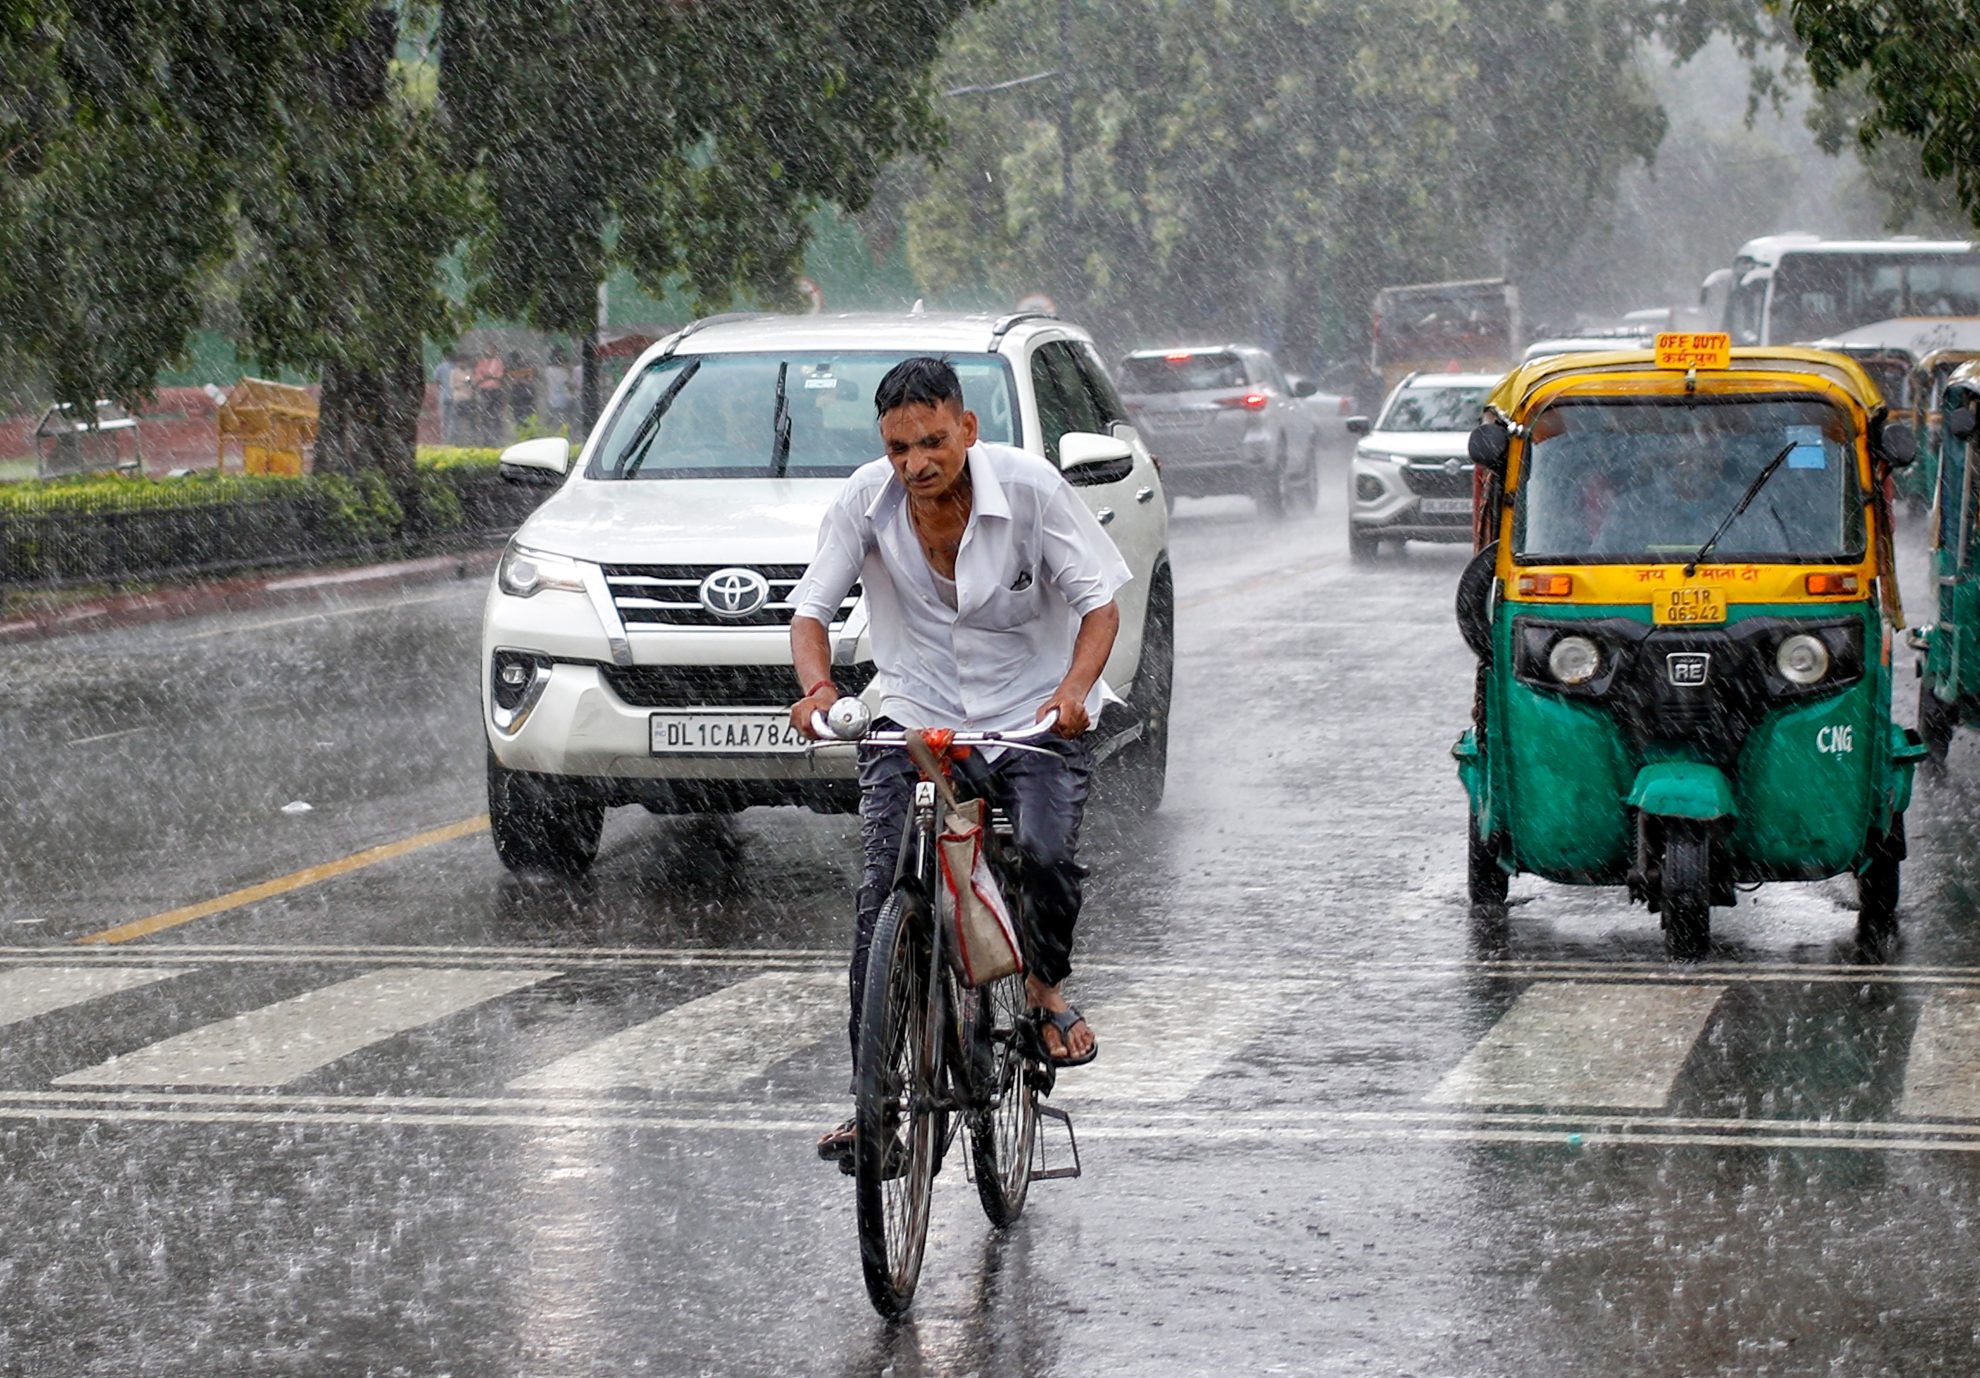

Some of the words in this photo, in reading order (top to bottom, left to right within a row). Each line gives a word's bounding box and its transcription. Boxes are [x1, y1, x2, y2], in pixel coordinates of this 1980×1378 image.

[1692, 335, 1726, 350] DUTY
[1675, 663, 1702, 681] RE
[1816, 724, 1853, 754] CNG
